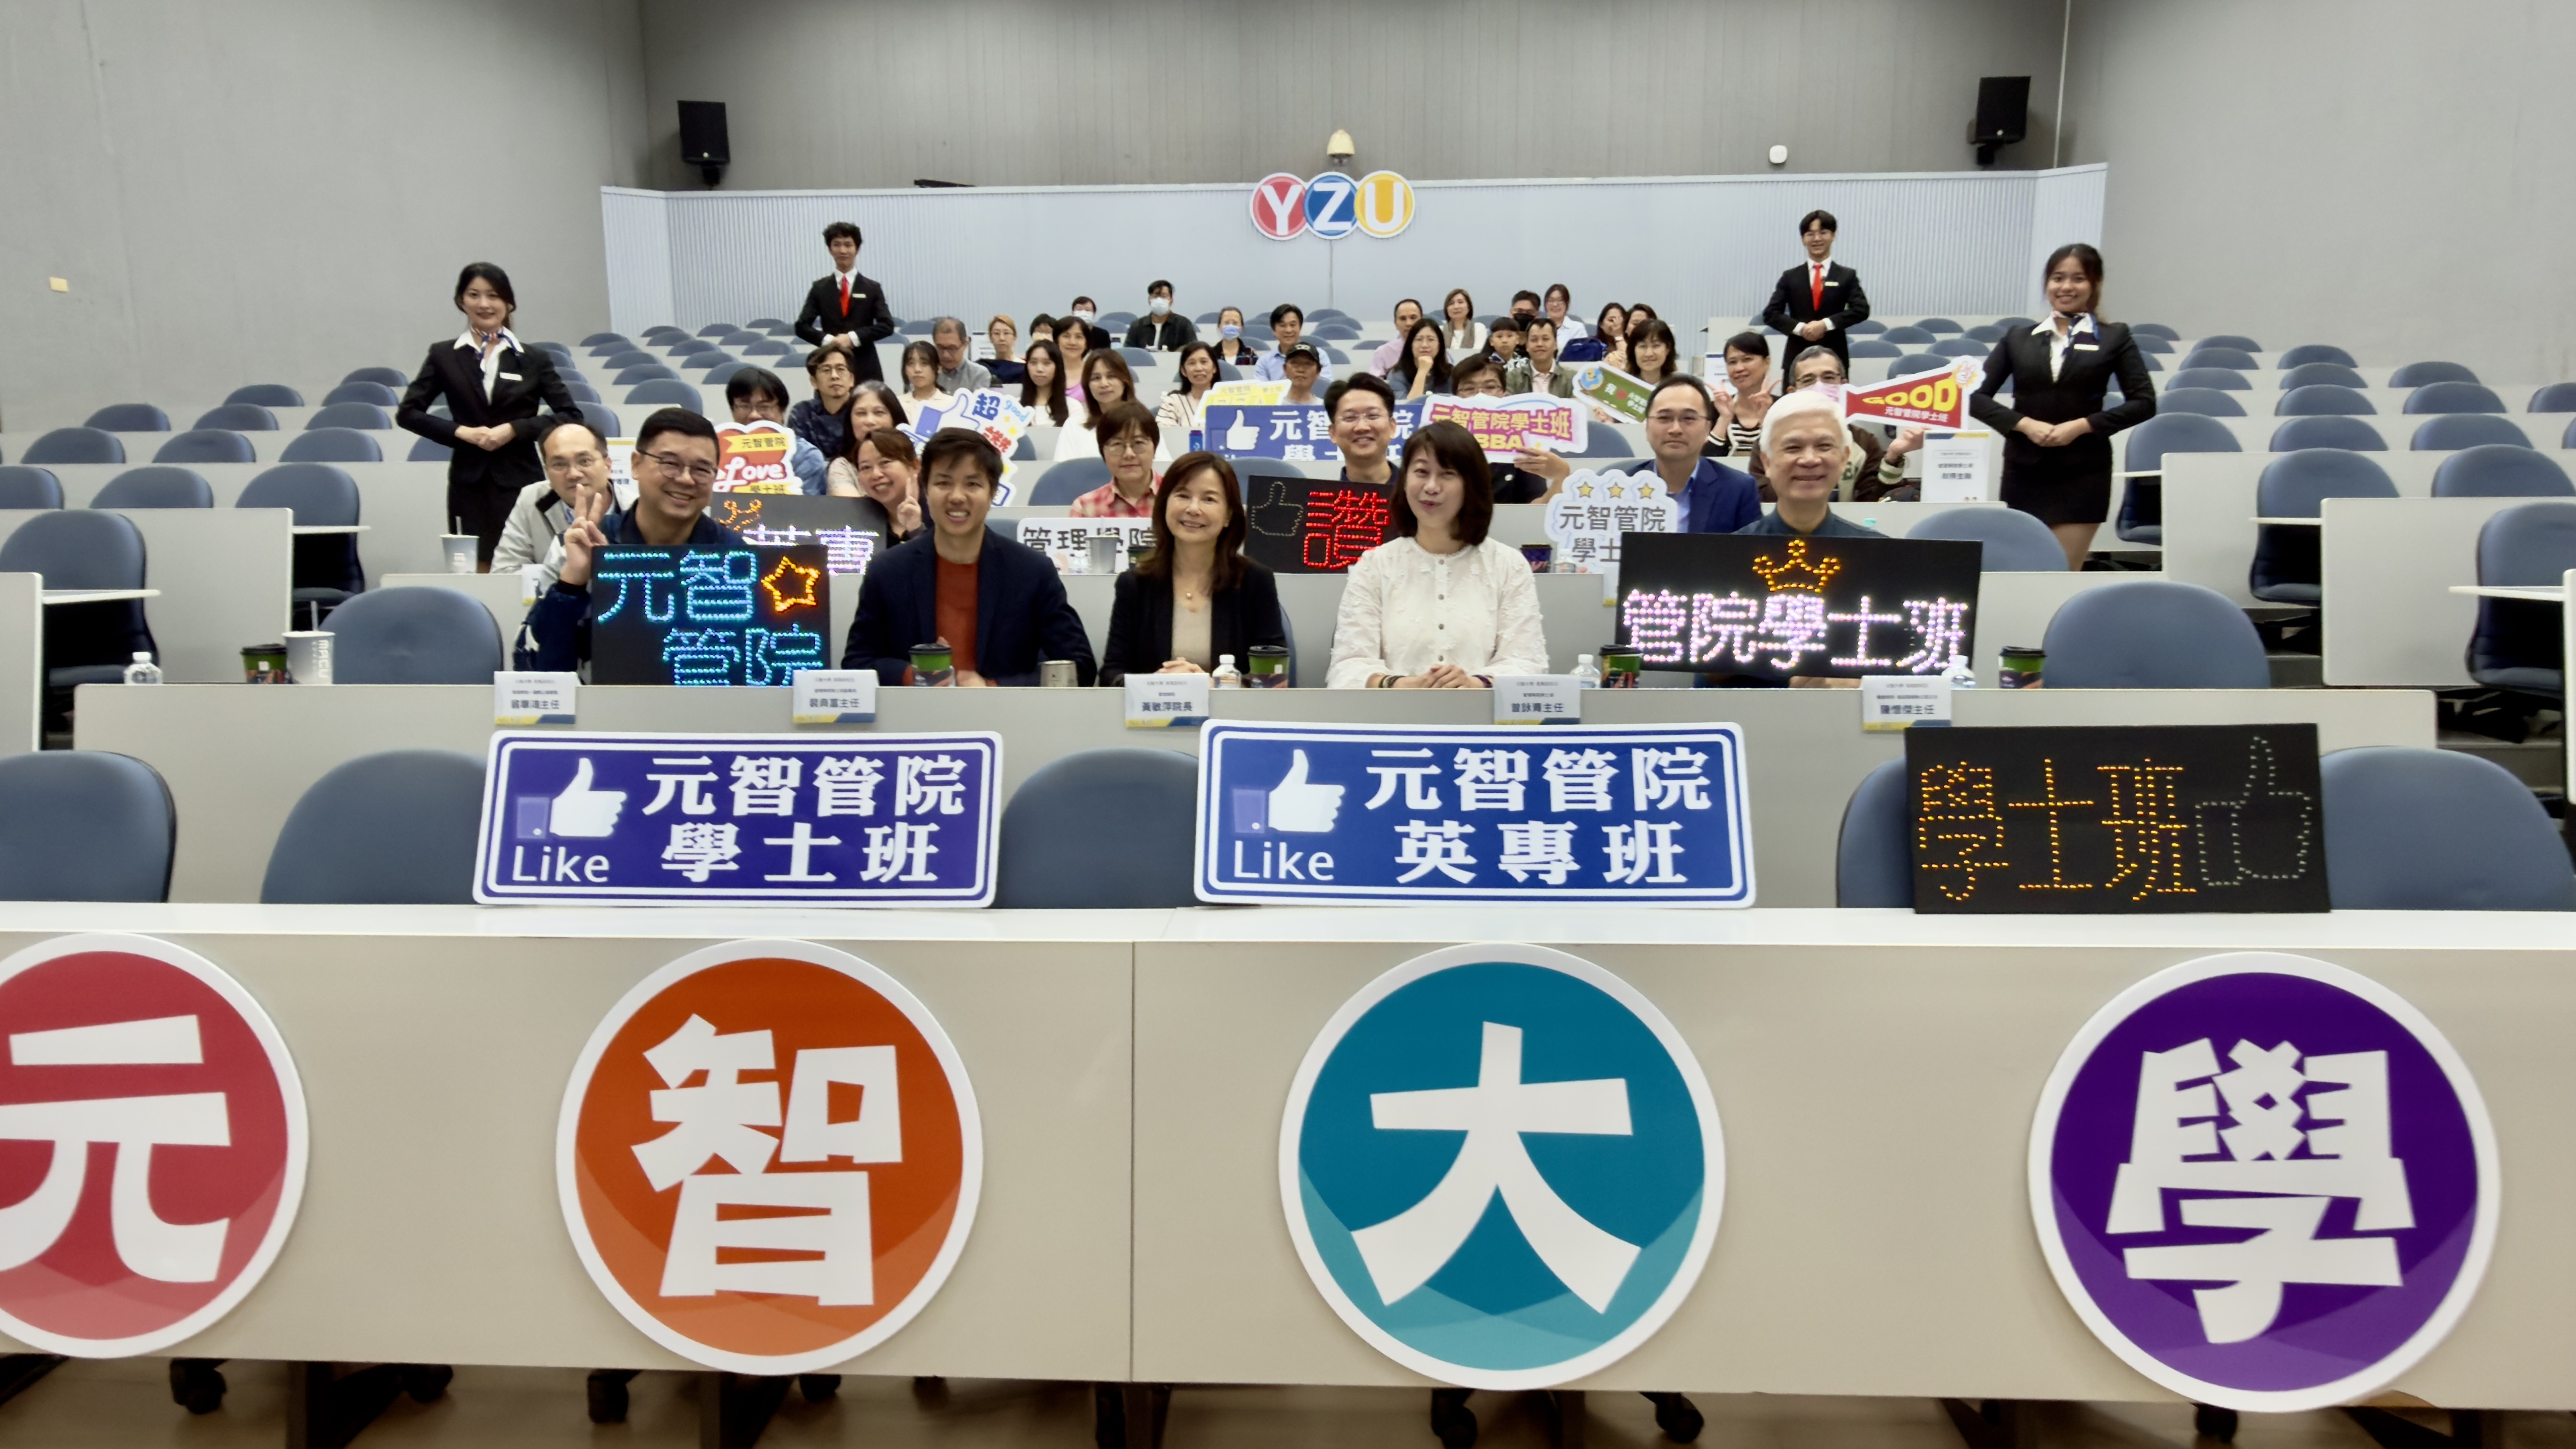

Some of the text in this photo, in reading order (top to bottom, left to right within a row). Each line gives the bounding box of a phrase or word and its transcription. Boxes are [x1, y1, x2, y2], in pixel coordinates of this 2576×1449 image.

[1260, 181, 1404, 235] YZU
[972, 393, 1000, 421] 超
[1004, 399, 1030, 422] good
[1862, 378, 1957, 412] GOOD
[1884, 406, 1949, 423] 元智管院學士班
[741, 437, 786, 449] 元智管院
[1270, 408, 1414, 441] 元智院
[712, 456, 785, 493] Love
[1304, 489, 1391, 571] 讚
[1560, 505, 1666, 532] 元智管院
[1572, 537, 1621, 563] 學士
[597, 549, 758, 623] 元智
[1623, 589, 1968, 672] 管院學士班
[662, 623, 824, 688] 管院
[642, 754, 967, 817] 元智管院
[1365, 747, 1711, 812] 元智管院
[661, 821, 940, 882] 學士班
[1394, 819, 1687, 884] 英專班
[1919, 760, 2198, 902] 學士班
[513, 846, 610, 882] Like
[1234, 841, 1334, 881] Like
[0, 1013, 2417, 1344] 元 智 大 學
